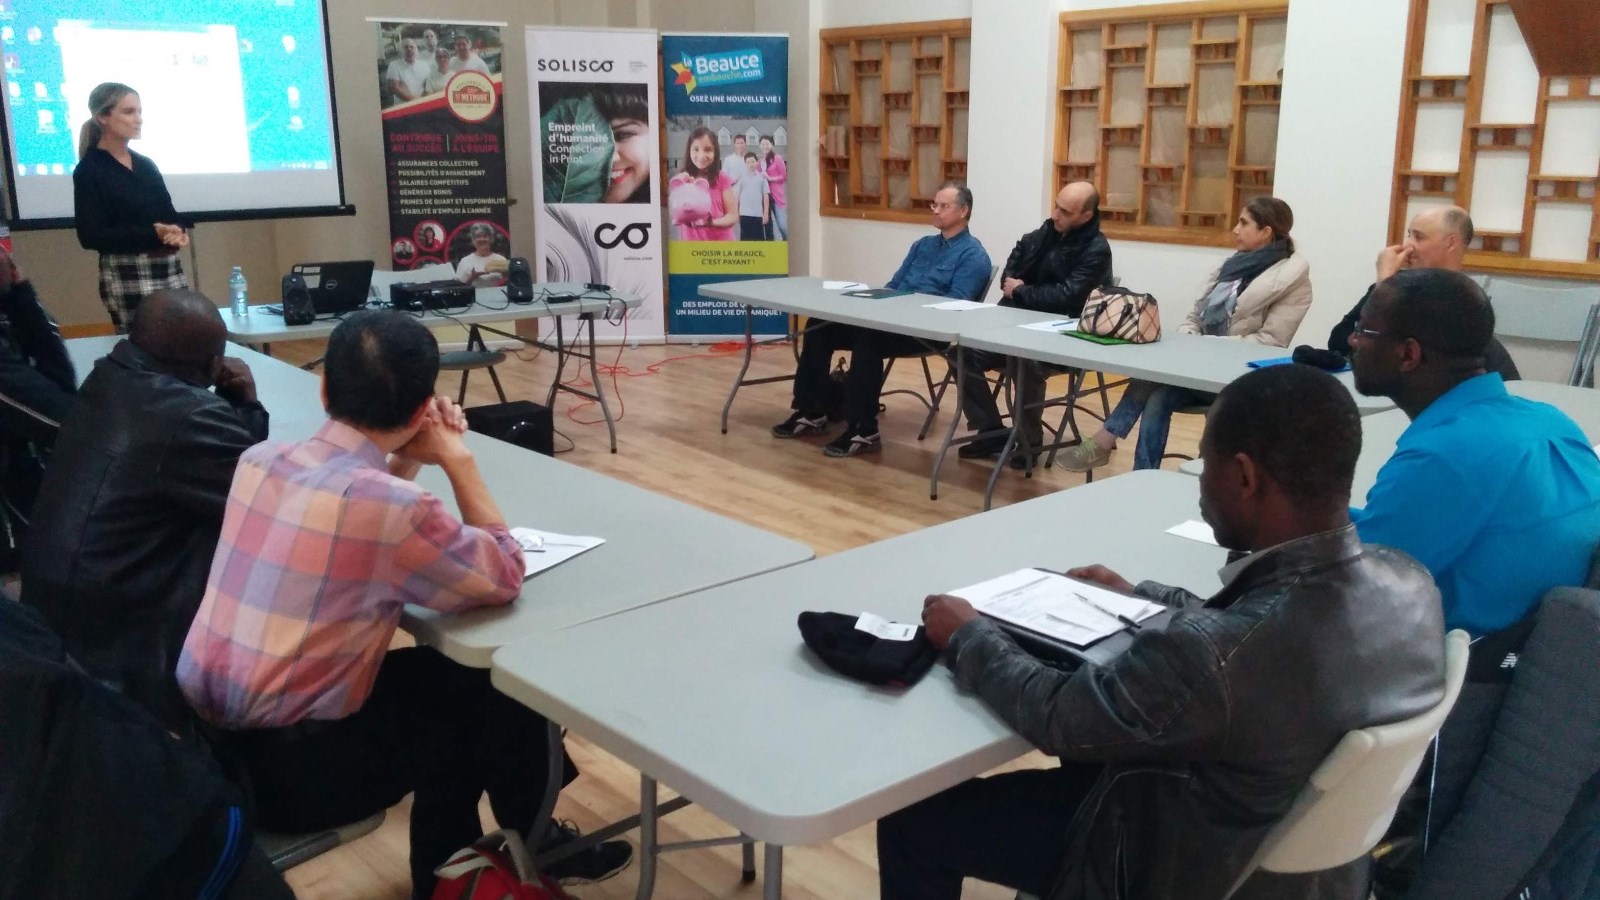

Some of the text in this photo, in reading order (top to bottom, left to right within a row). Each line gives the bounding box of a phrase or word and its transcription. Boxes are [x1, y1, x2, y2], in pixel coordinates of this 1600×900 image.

[683, 54, 760, 74] la Beauce
[690, 95, 709, 103] OSEZ
[710, 95, 725, 103] UNE
[726, 95, 764, 103] NOUVELLE
[765, 95, 778, 103] VIE
[548, 122, 596, 133] Empreint
[548, 133, 609, 143] d'humanité
[548, 143, 605, 153] Connection
[549, 154, 583, 164] in Print
[734, 250, 766, 258] BEAUCE,
